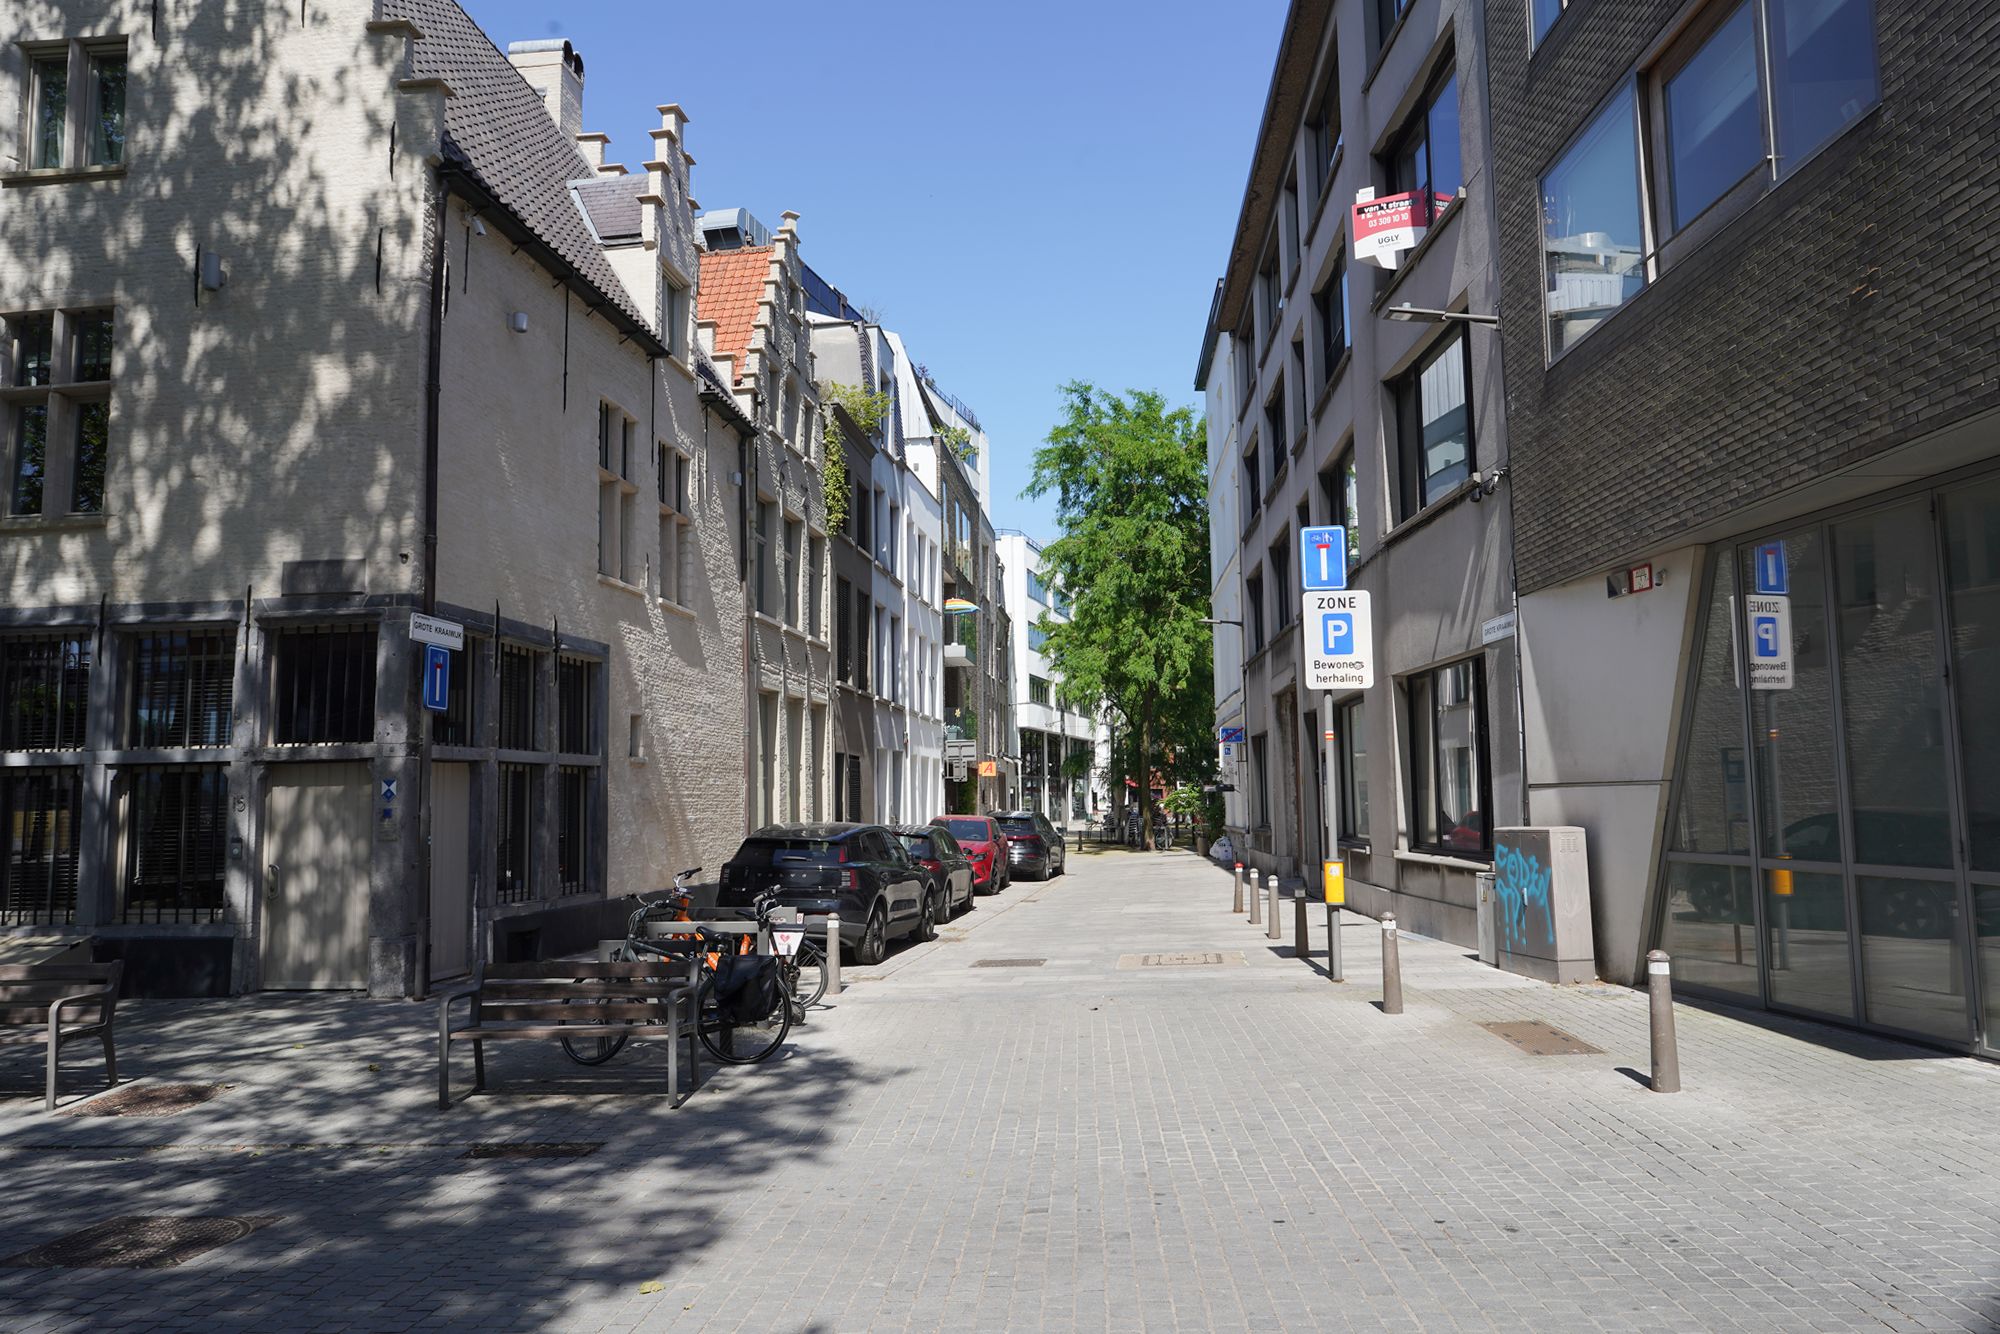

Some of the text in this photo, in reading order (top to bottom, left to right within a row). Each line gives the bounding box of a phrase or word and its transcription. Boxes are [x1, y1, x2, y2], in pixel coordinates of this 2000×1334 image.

[1363, 205, 1379, 213] van
[1368, 219, 1378, 228] 03
[1392, 214, 1400, 223] 10
[1401, 212, 1409, 221] 10
[1378, 234, 1400, 245] UGLY
[1317, 596, 1356, 609] ZONE
[414, 621, 432, 633] GROTE
[1327, 620, 1348, 649] P
[1314, 660, 1364, 670] Bewone
[1316, 673, 1363, 684] herhaling
[984, 763, 993, 774] A
